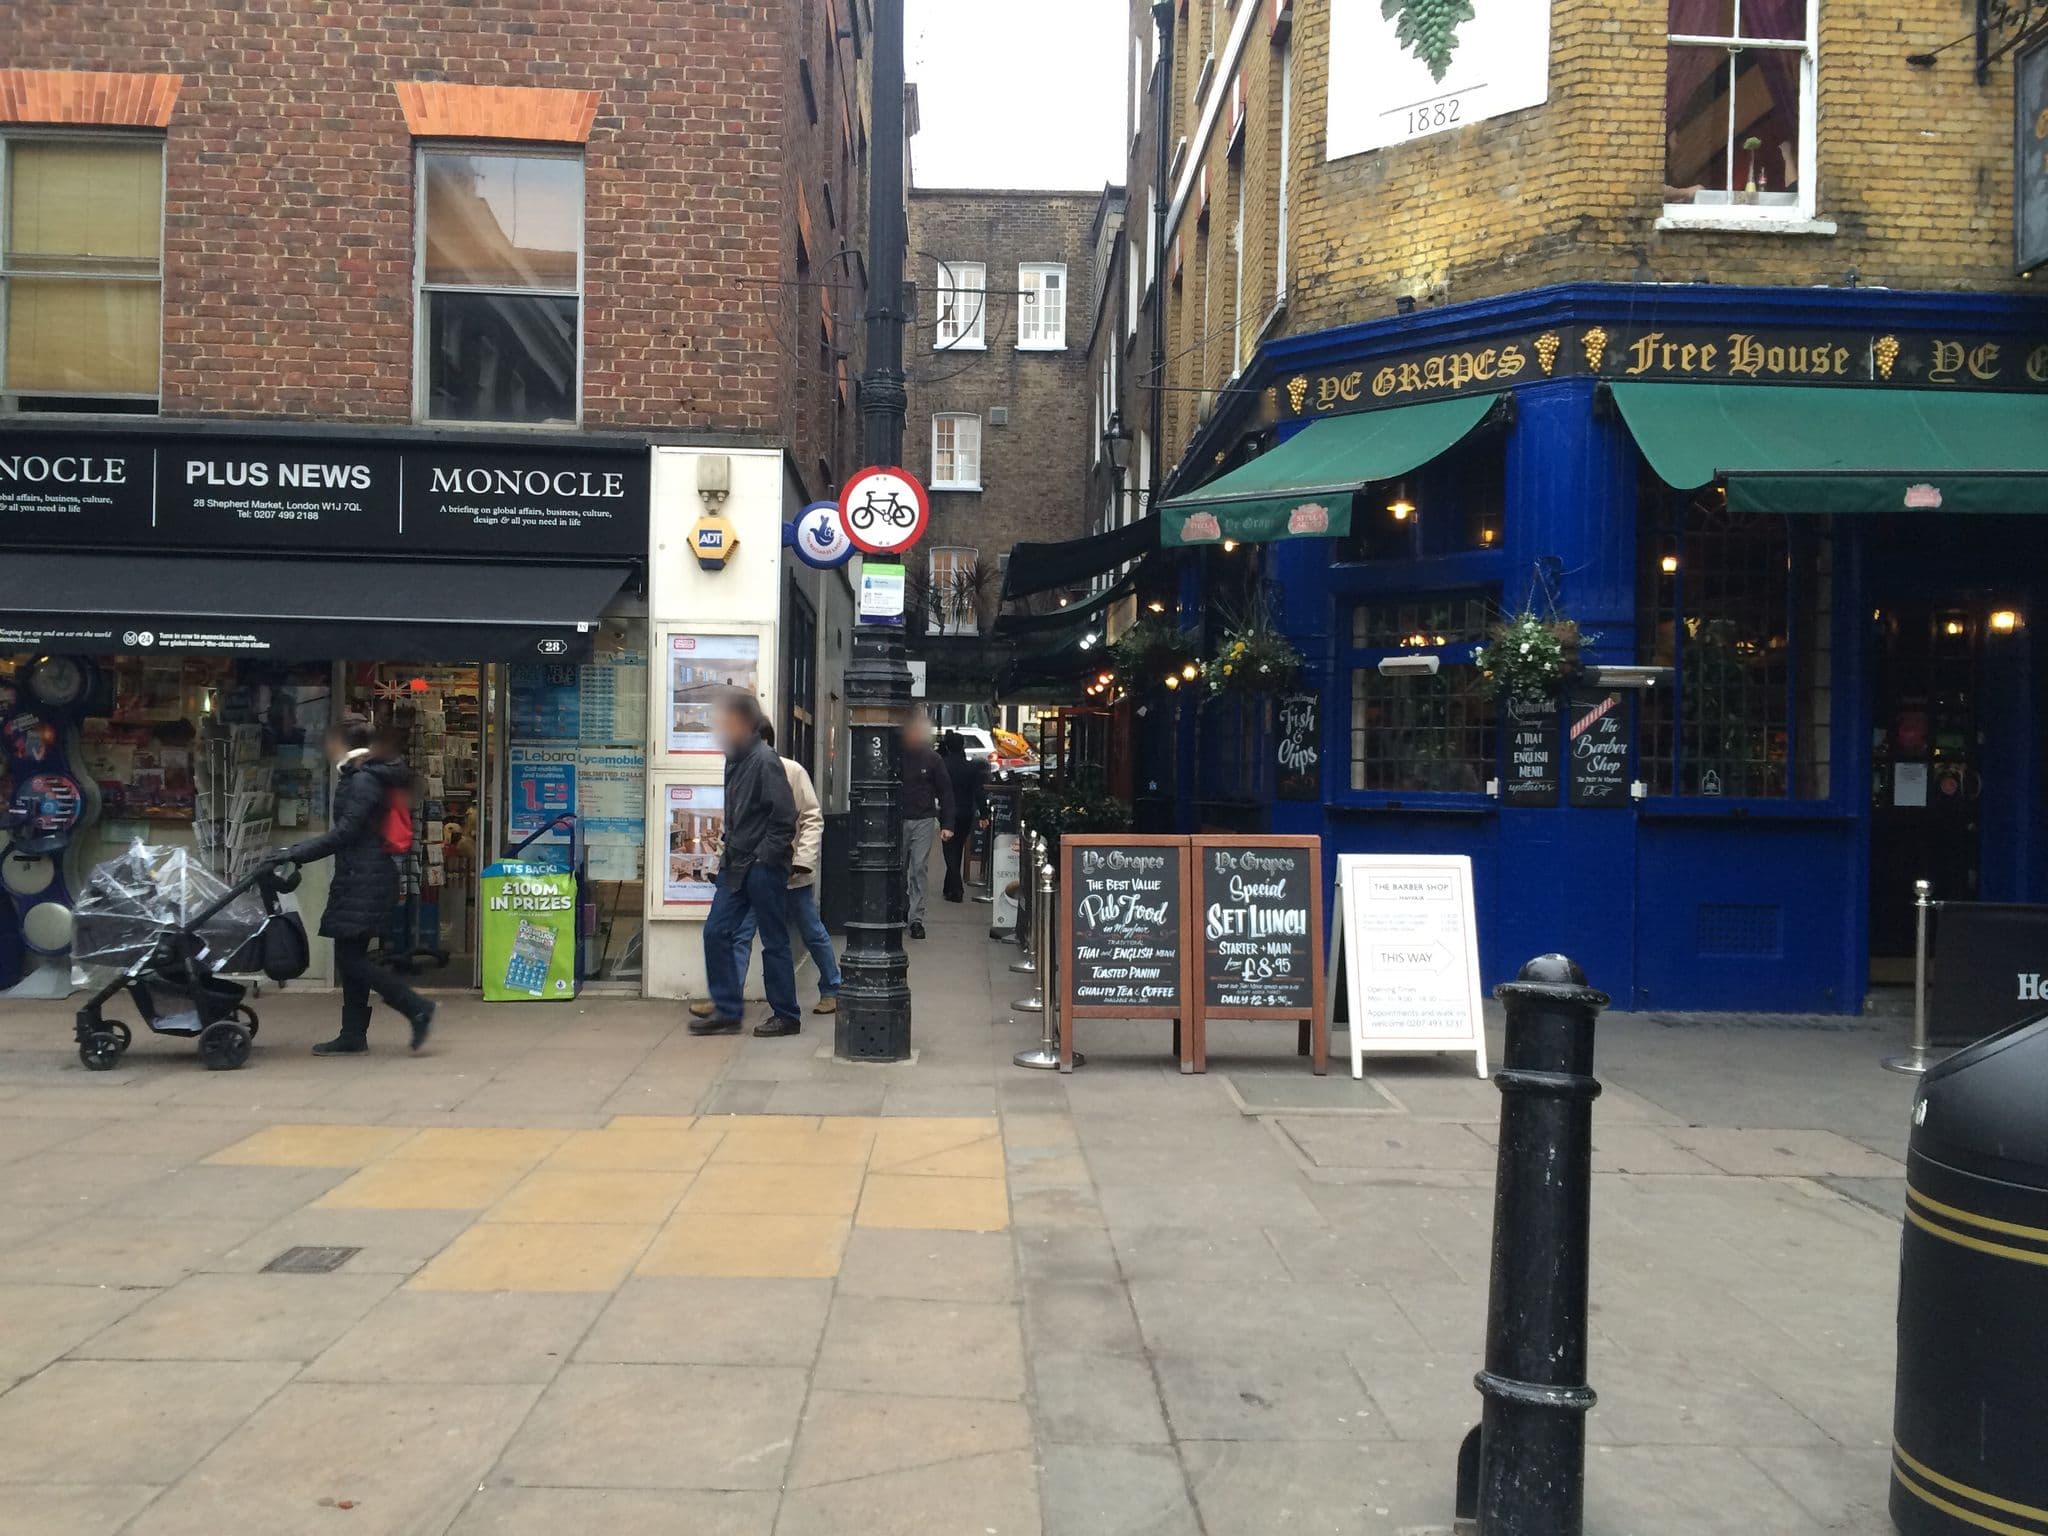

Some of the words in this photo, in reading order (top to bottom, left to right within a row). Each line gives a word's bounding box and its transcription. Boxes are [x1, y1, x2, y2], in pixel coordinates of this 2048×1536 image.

[1408, 99, 1460, 134] 1882
[1626, 332, 1718, 376] Free
[1727, 332, 1850, 378] House
[1928, 340, 2002, 383] YE
[1316, 371, 1364, 411] YE
[1372, 344, 1527, 397] GRAPES
[186, 461, 269, 487] PLUS
[278, 463, 371, 489] NEWS
[430, 467, 625, 498] MONOCLE
[20, 504, 35, 513] you
[37, 504, 56, 512] need
[58, 504, 66, 512] in
[68, 504, 81, 513] life
[193, 499, 205, 507] 28
[207, 499, 249, 510] Shepherd
[251, 501, 284, 511] Market,
[286, 502, 320, 511] London
[321, 502, 342, 511] W1J
[343, 503, 362, 512] 7QL
[440, 505, 447, 513] A
[449, 505, 479, 516] briefing
[493, 506, 516, 516] global
[518, 507, 545, 517] affairs,
[546, 508, 581, 518] business,
[582, 509, 612, 519] culture,
[237, 510, 252, 519] Tel:
[253, 510, 275, 519] 0207
[278, 511, 295, 520] 499
[297, 511, 319, 520] 2188
[473, 516, 498, 527] design
[501, 517, 510, 525] &
[511, 517, 520, 525] all
[522, 519, 537, 528] you
[538, 518, 557, 526] need
[559, 518, 567, 526] in
[569, 518, 581, 527] life
[700, 533, 722, 544] ADT
[545, 642, 560, 651] 28
[1279, 704, 1315, 735] Fish
[1600, 717, 1619, 733] The
[872, 736, 881, 749] 3
[1573, 734, 1628, 758] Barber
[525, 749, 576, 762] Lebara
[579, 755, 644, 767] Lycamobile
[1278, 739, 1318, 775] Chips
[1513, 751, 1549, 763] ENGLISH
[1519, 766, 1543, 777] MENU
[1587, 755, 1620, 774] Shop
[502, 864, 524, 873] IT'S
[525, 864, 558, 874] BACK!
[1107, 850, 1164, 875] Grapes
[1240, 851, 1295, 877] Grapes
[502, 882, 558, 896] £100M
[1229, 874, 1287, 904] Special
[1374, 883, 1390, 891] THE
[1392, 883, 1424, 891] BARBER
[1427, 883, 1449, 891] SHOP
[490, 896, 508, 911] IN
[513, 896, 571, 910] PRIZES
[1078, 894, 1120, 929] Pub
[1118, 894, 1169, 925] Food
[1206, 903, 1247, 940] SET
[1248, 904, 1306, 938] LUNCH
[1077, 946, 1100, 959] THAI
[1113, 947, 1153, 962] ENGLISH
[1219, 941, 1259, 955] STARTER
[1267, 942, 1292, 957] MAIN
[1381, 953, 1405, 963] THIS
[1407, 953, 1433, 963] WAY
[1092, 966, 1128, 979] TOASTED
[1129, 966, 1160, 979] PANINI
[1077, 986, 1116, 997] QUALITY
[1116, 985, 1134, 997] TEA
[1141, 986, 1175, 998] COFFEE
[1221, 995, 1249, 1005] DAILY
